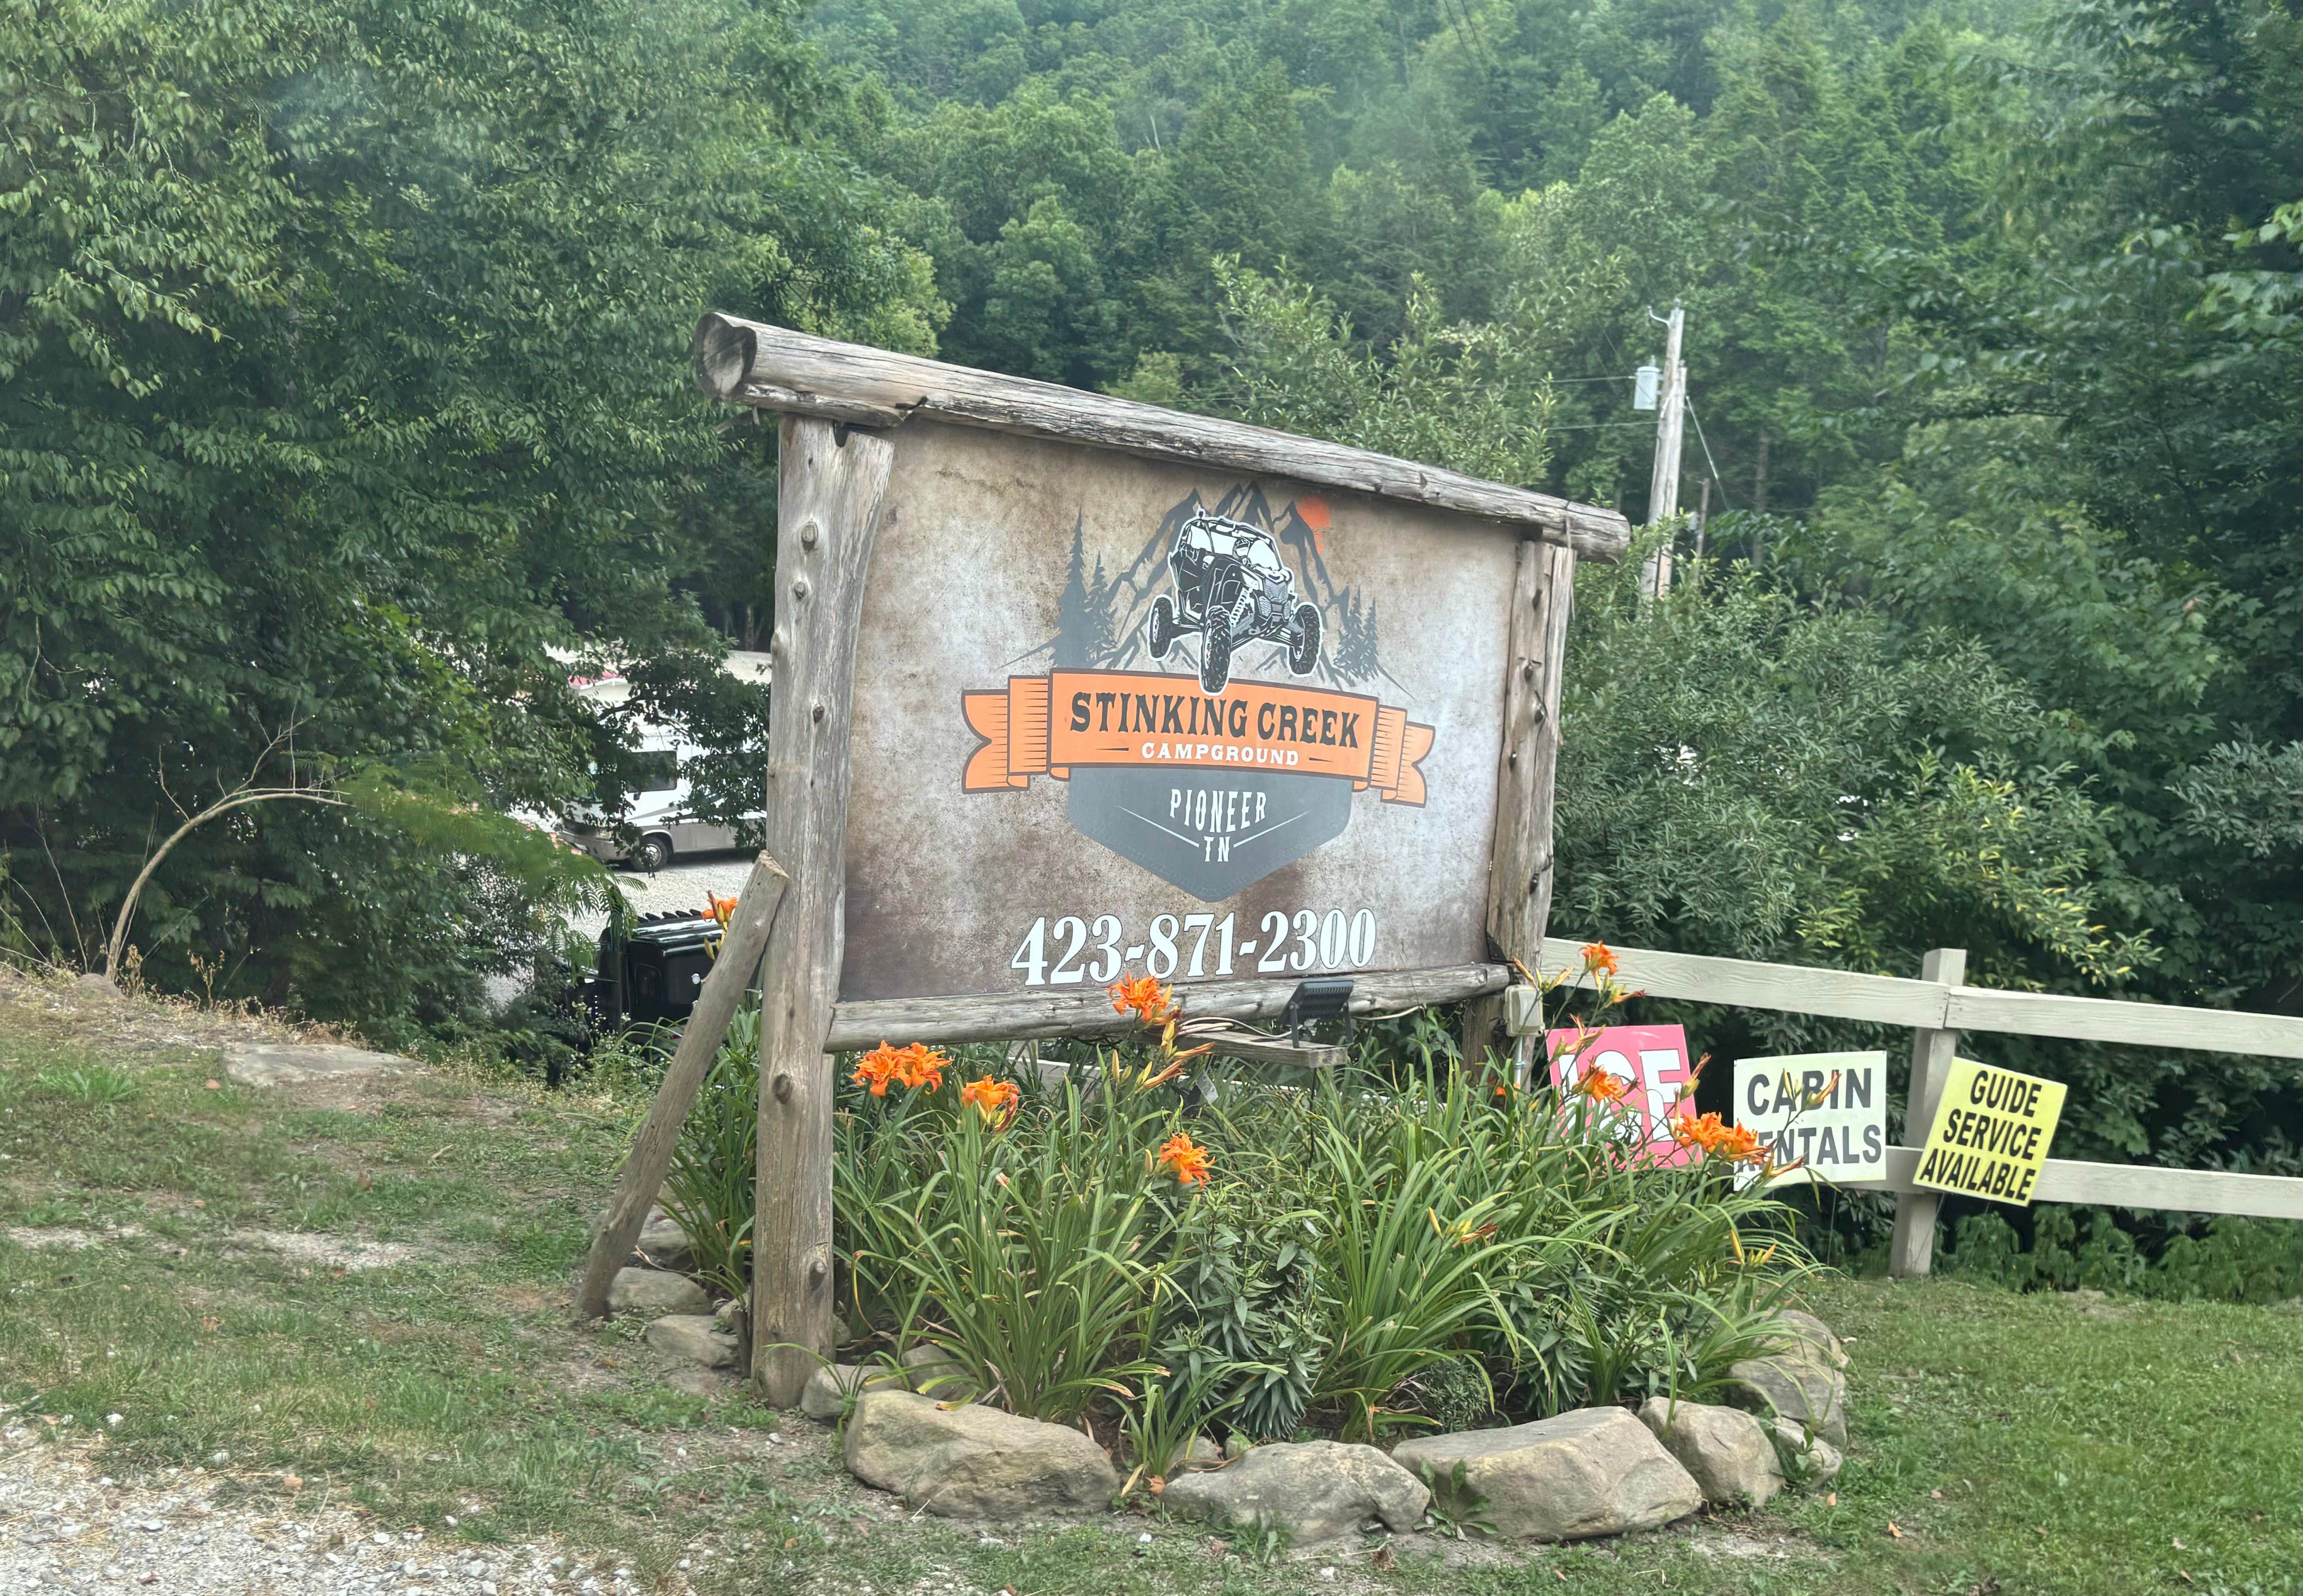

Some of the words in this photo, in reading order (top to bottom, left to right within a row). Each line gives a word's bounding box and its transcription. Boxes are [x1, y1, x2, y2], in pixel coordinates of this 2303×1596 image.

[1070, 691, 1247, 737] STINKING
[1257, 703, 1362, 749] CREEK
[1141, 742, 1299, 766] CAMPGROUND
[1169, 788, 1267, 833] PIONEER
[1204, 836, 1230, 863] TN
[1011, 908, 1376, 986] 423-871-2300
[1747, 1068, 1871, 1116] CABIN
[1970, 1070, 2042, 1117] GUIDE
[1736, 1125, 1882, 1172] ENTALS
[1943, 1108, 2042, 1160] SERVICE
[1919, 1148, 2036, 1201] AVAILABLE
